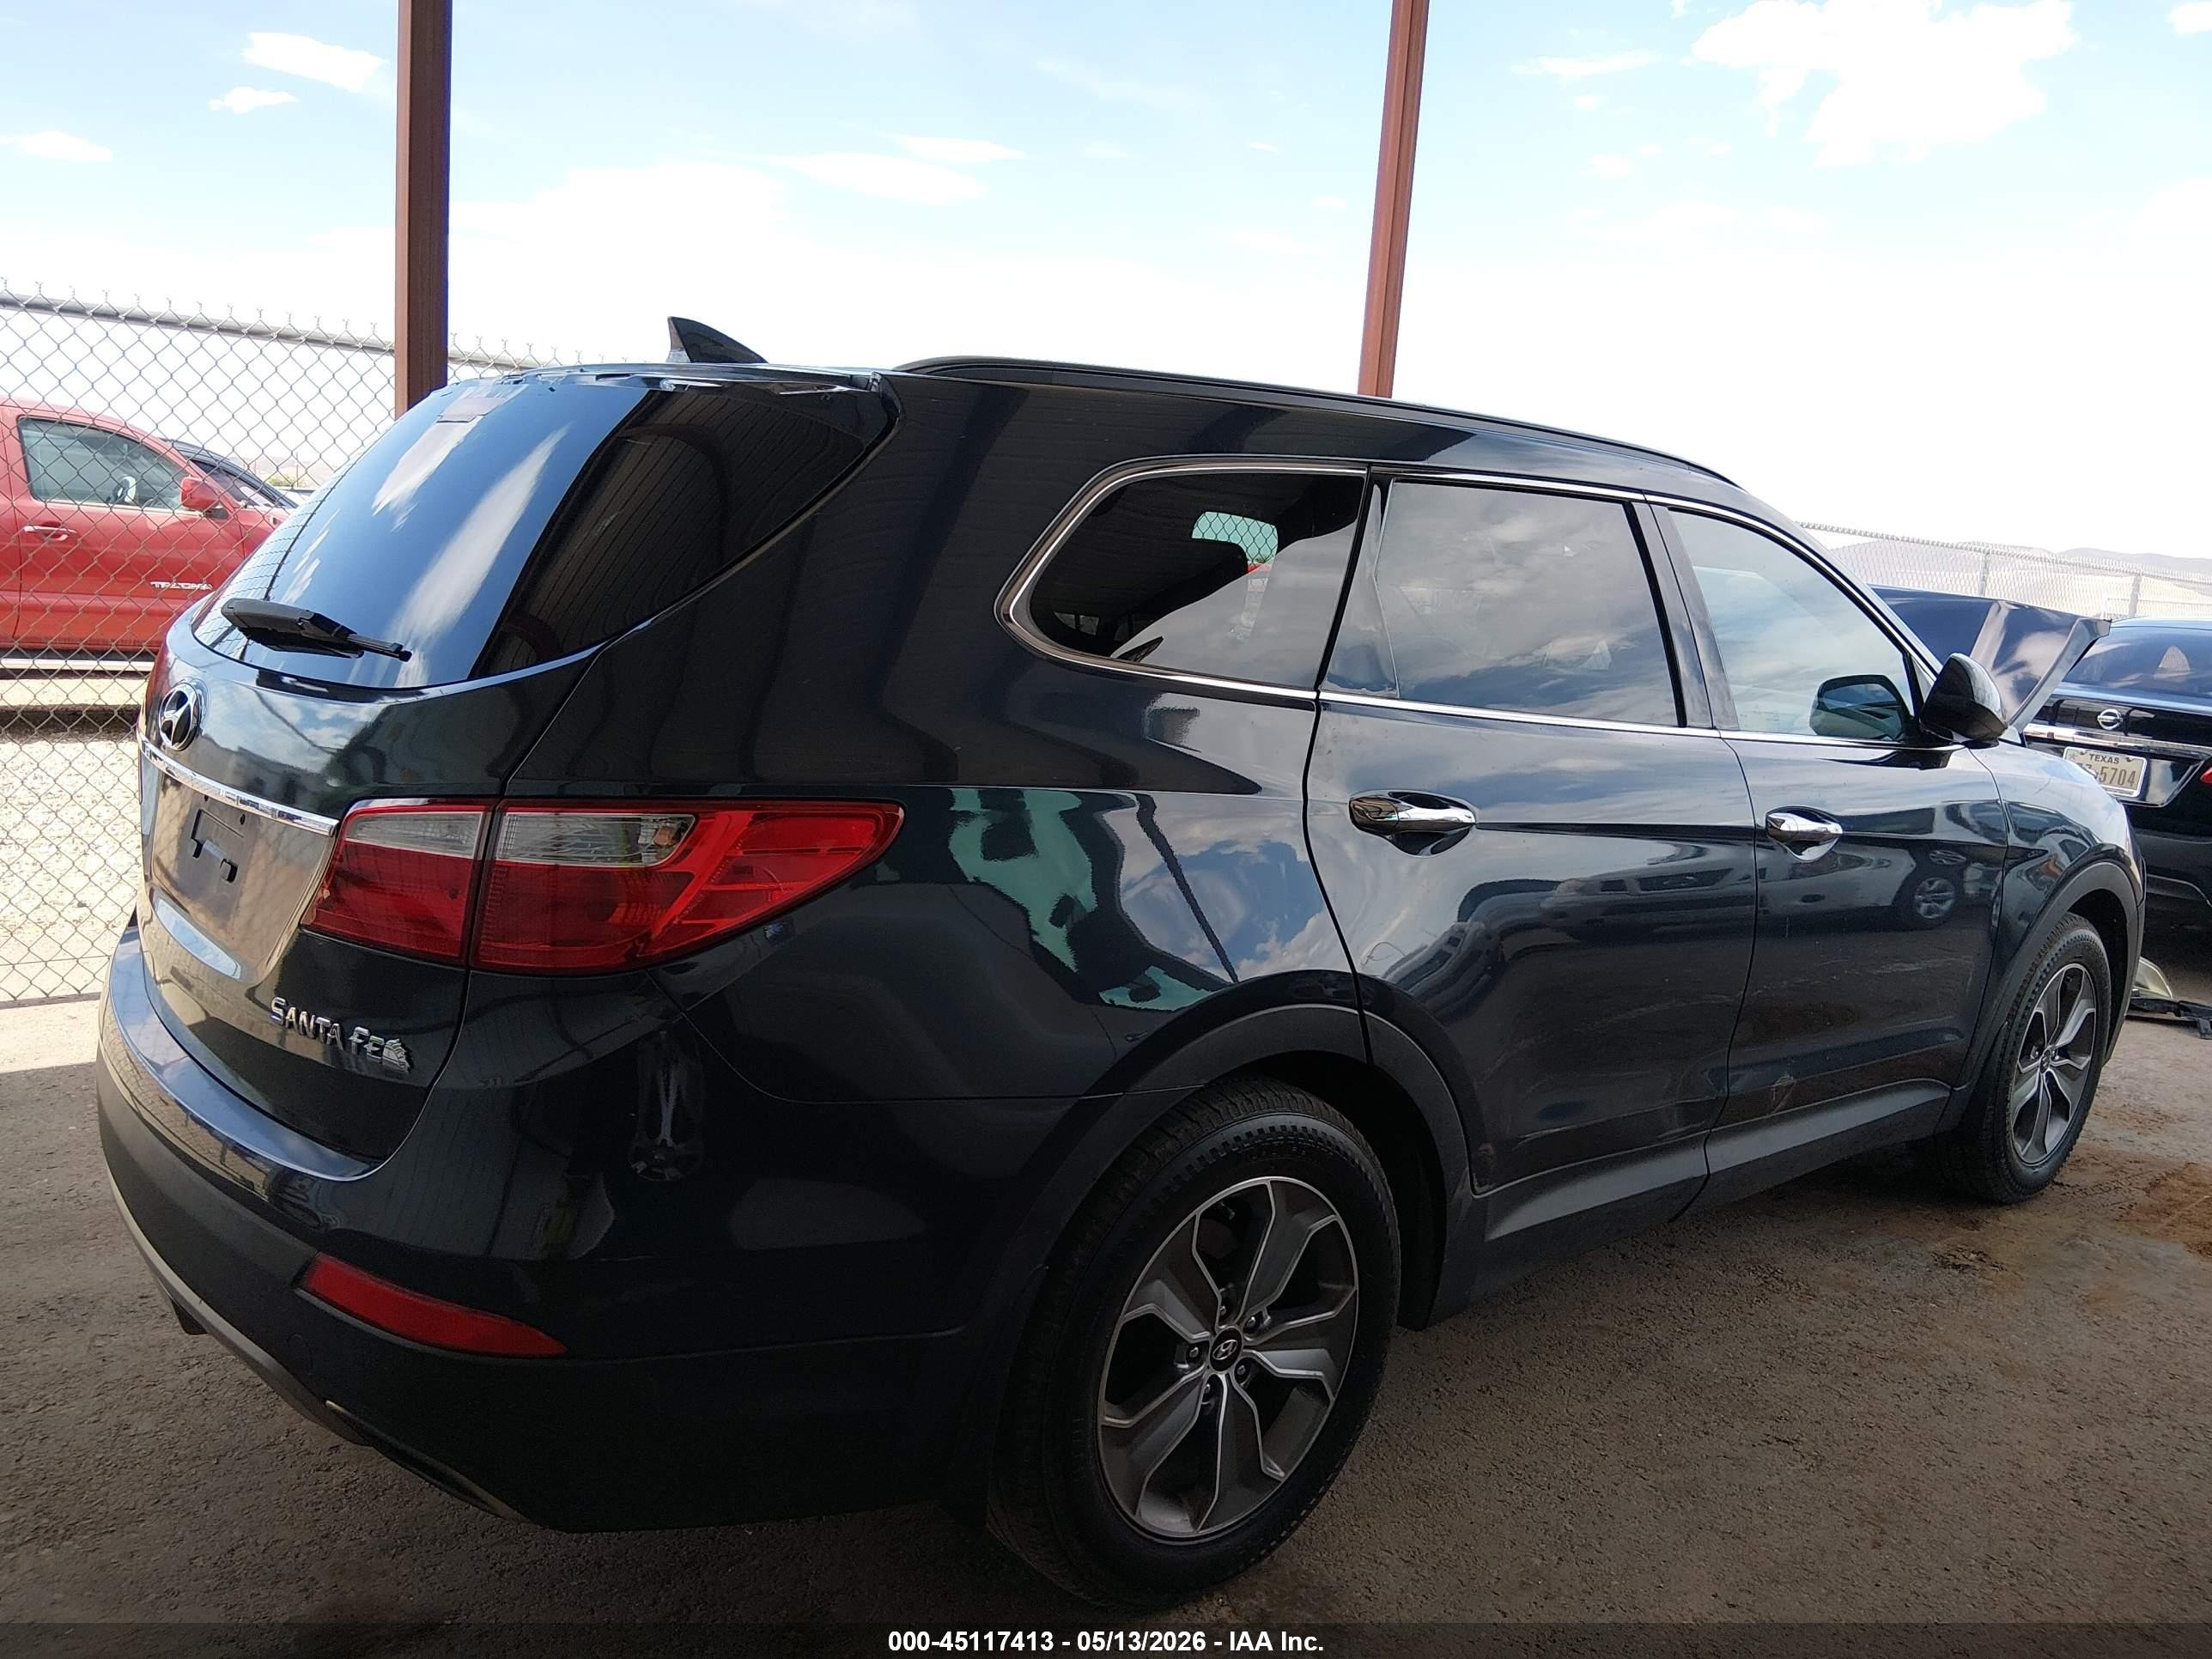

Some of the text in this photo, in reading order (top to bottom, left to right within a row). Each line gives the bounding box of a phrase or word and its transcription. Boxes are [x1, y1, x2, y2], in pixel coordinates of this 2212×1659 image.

[2088, 753, 2120, 764] TEXAS
[270, 996, 385, 1064] SANTA FE
